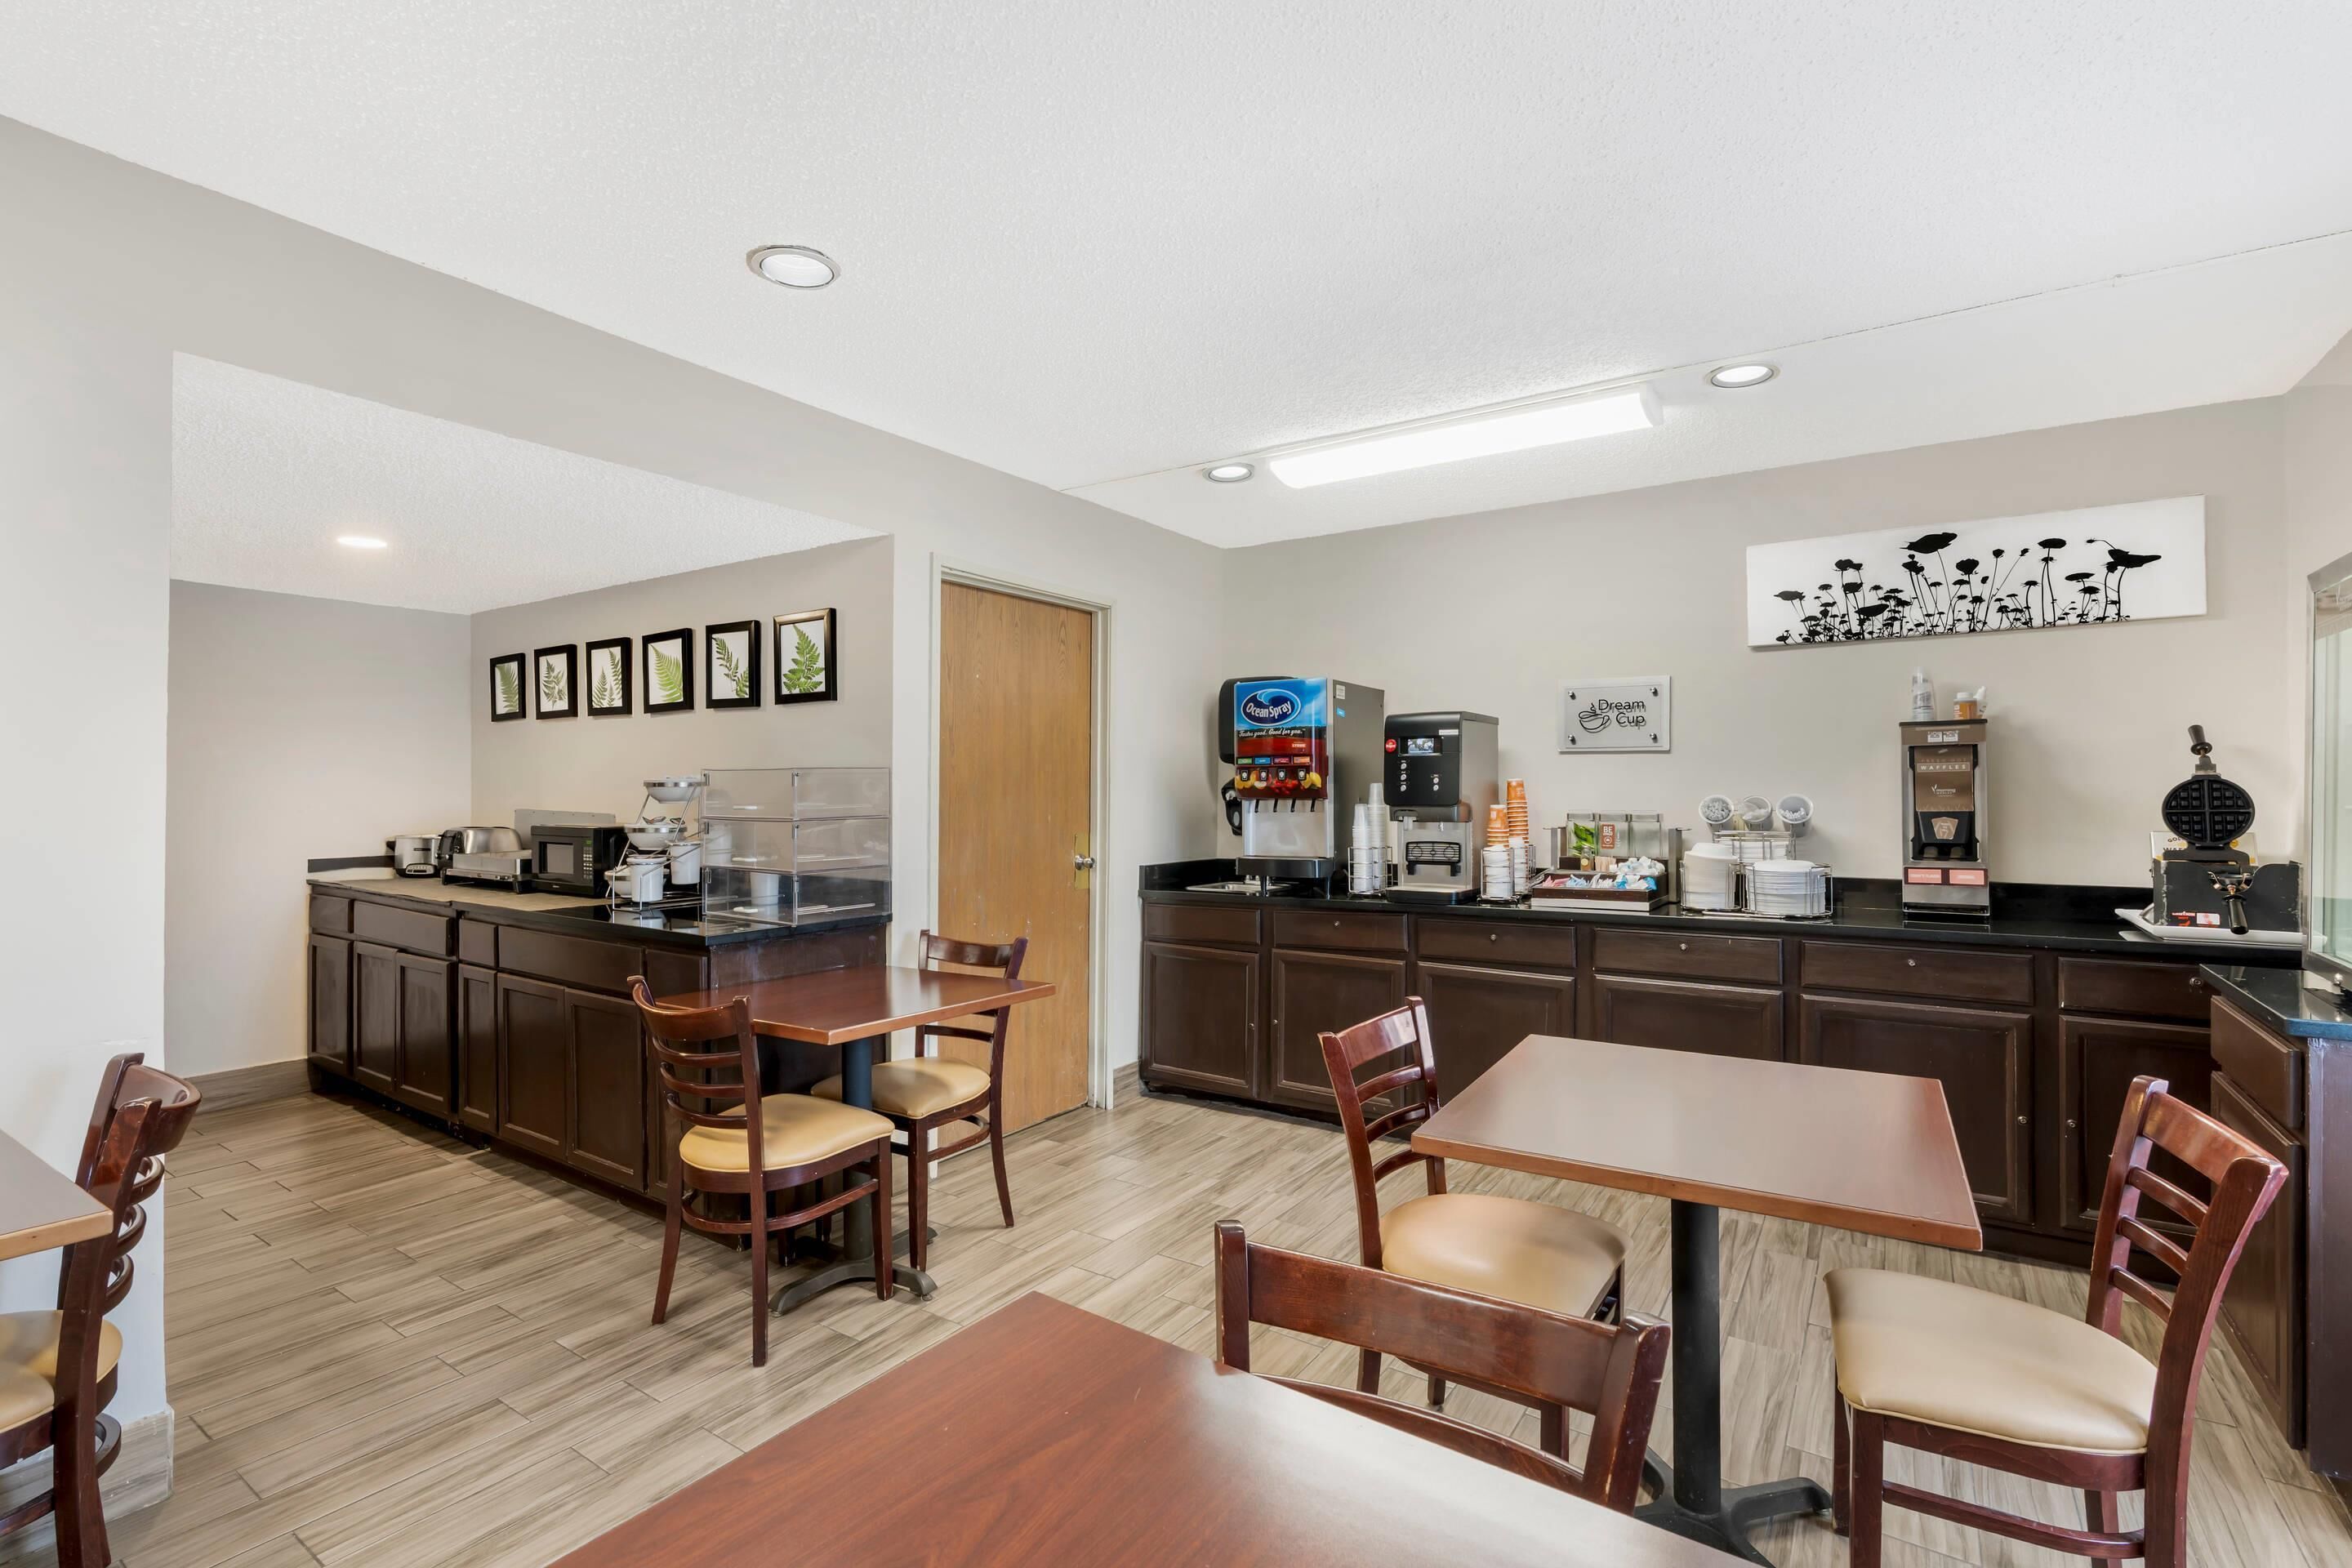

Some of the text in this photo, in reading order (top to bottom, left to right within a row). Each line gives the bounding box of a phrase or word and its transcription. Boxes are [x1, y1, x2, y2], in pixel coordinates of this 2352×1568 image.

[1245, 701, 1292, 719] Ocean Spray
[1598, 699, 1644, 710] Dream
[1616, 712, 1645, 727] Cup
